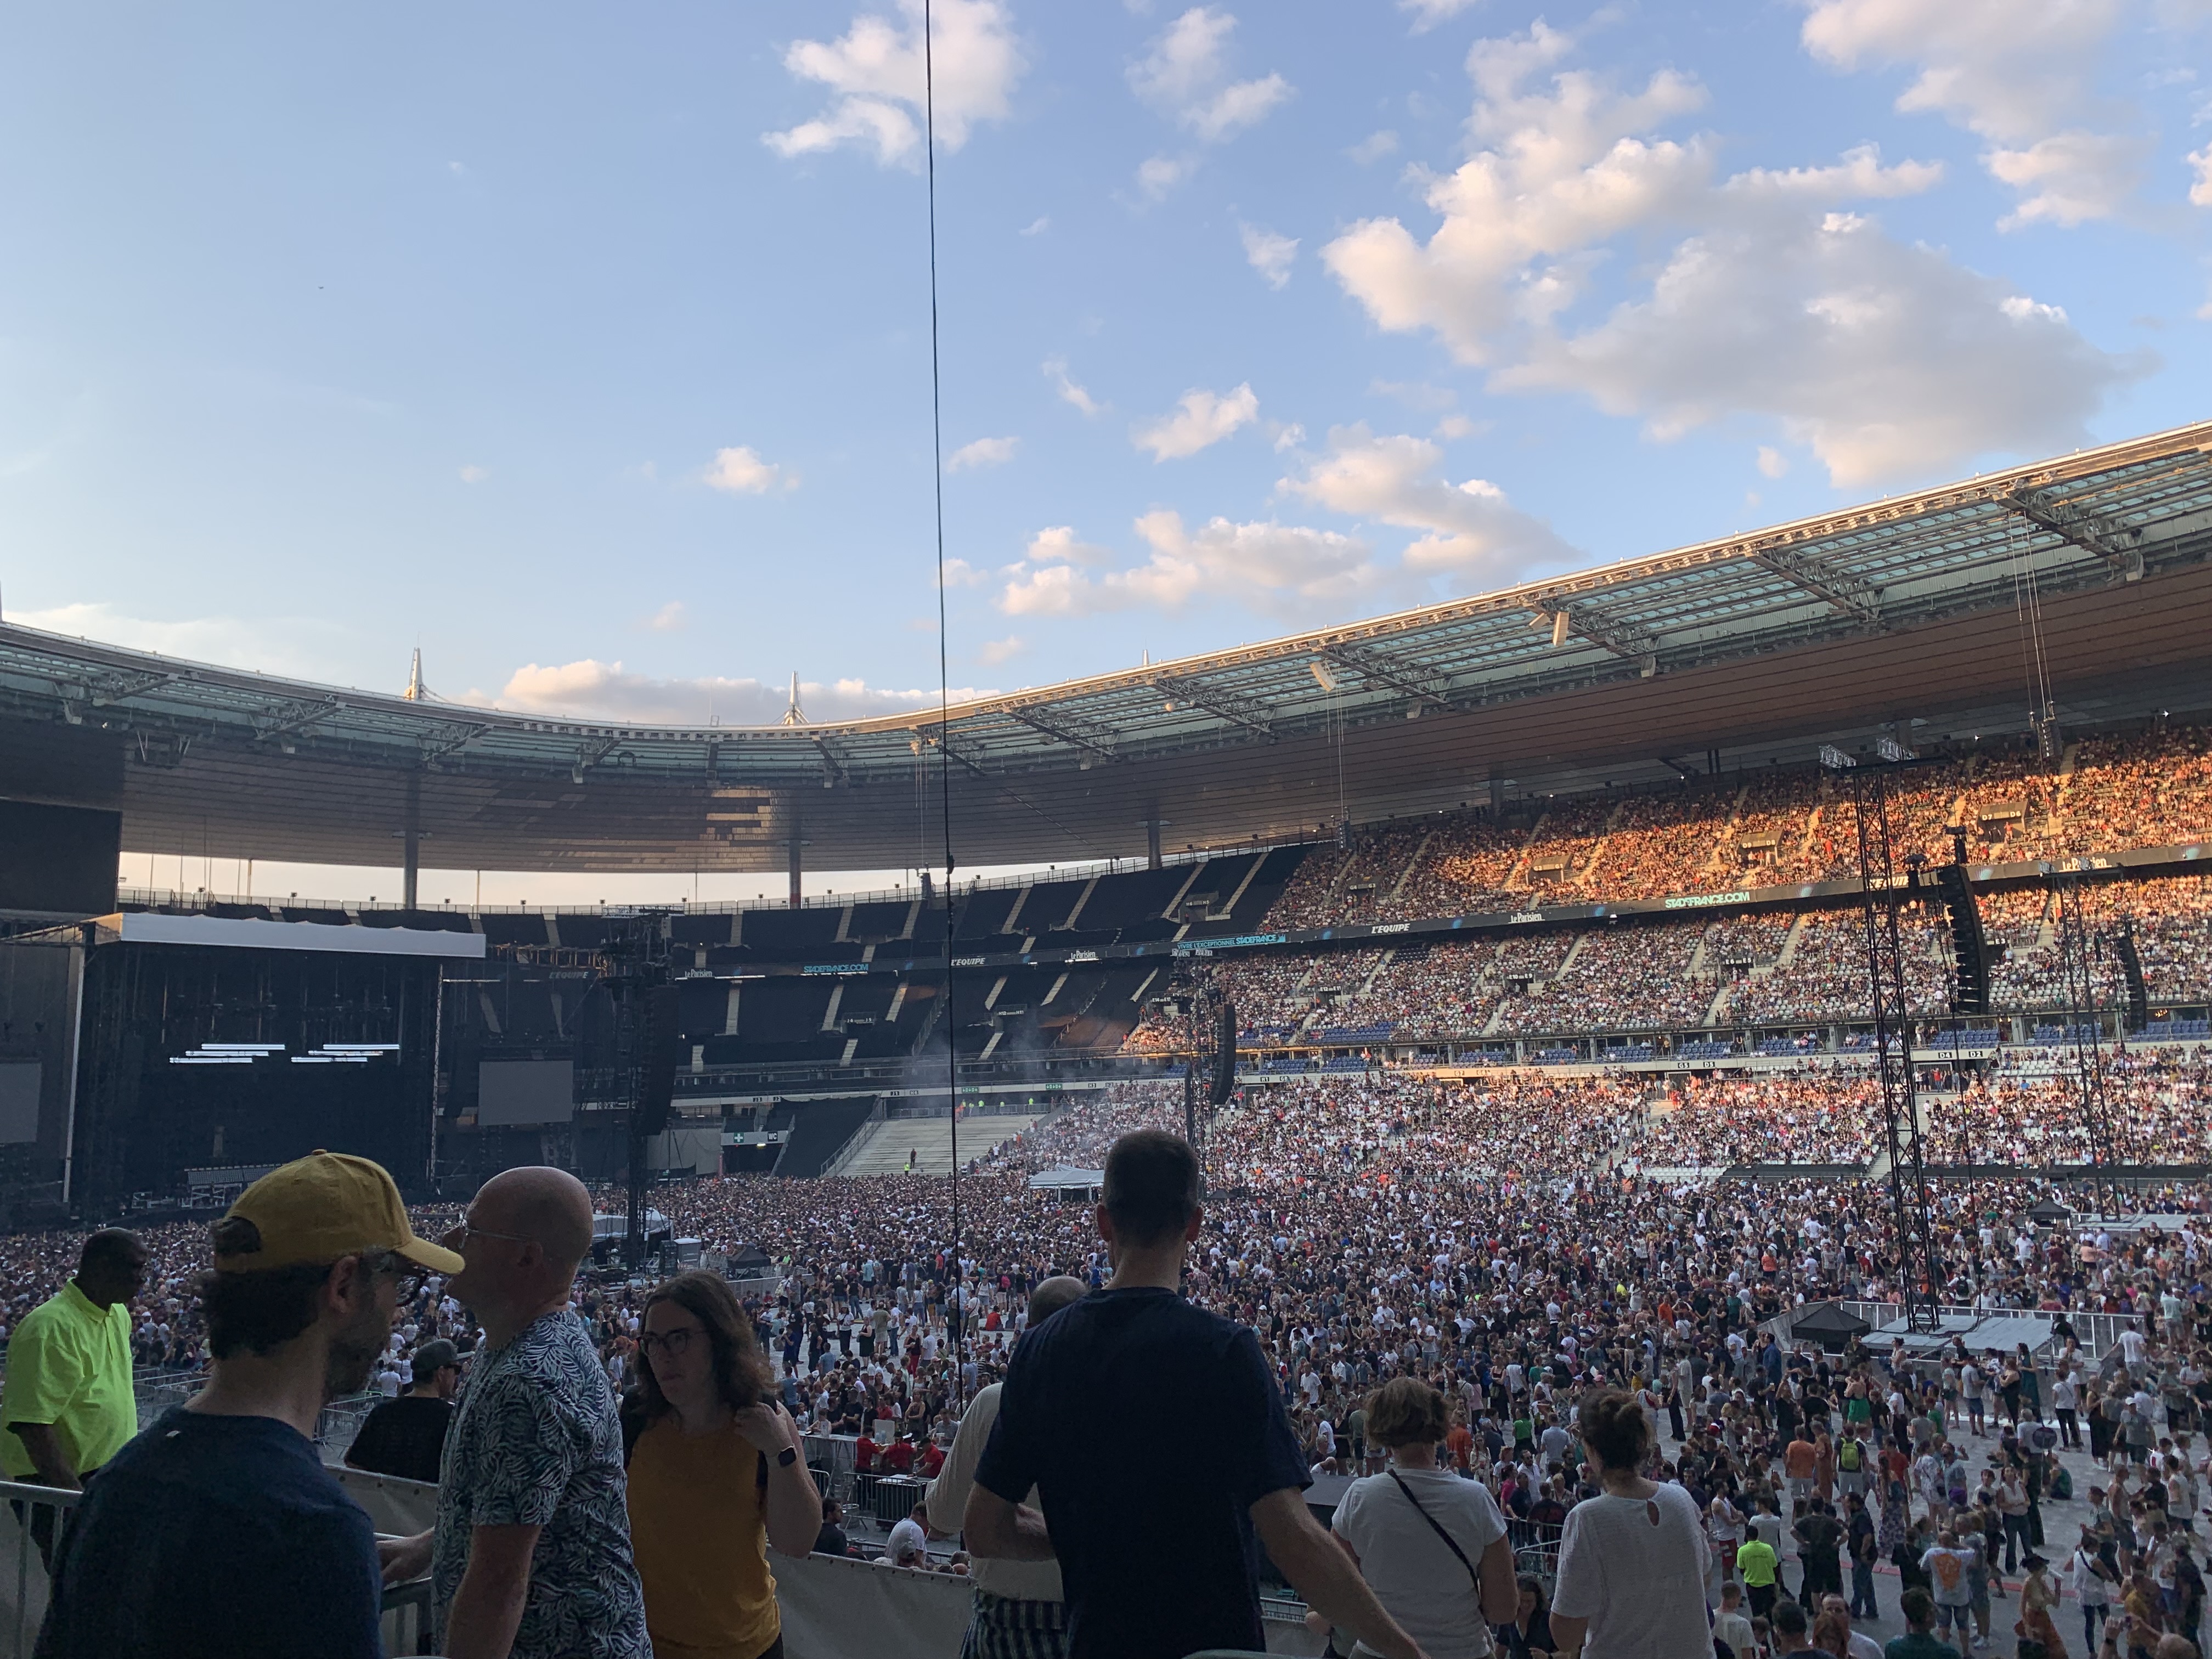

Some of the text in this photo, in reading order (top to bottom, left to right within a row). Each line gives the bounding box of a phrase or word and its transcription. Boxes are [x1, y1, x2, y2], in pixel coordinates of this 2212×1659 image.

[1510, 912, 1543, 923] Le Parisien
[1194, 939, 1235, 949] L'EXCEPTIONNEL
[1076, 950, 1096, 959] Parisien
[691, 968, 713, 977] Parisien
